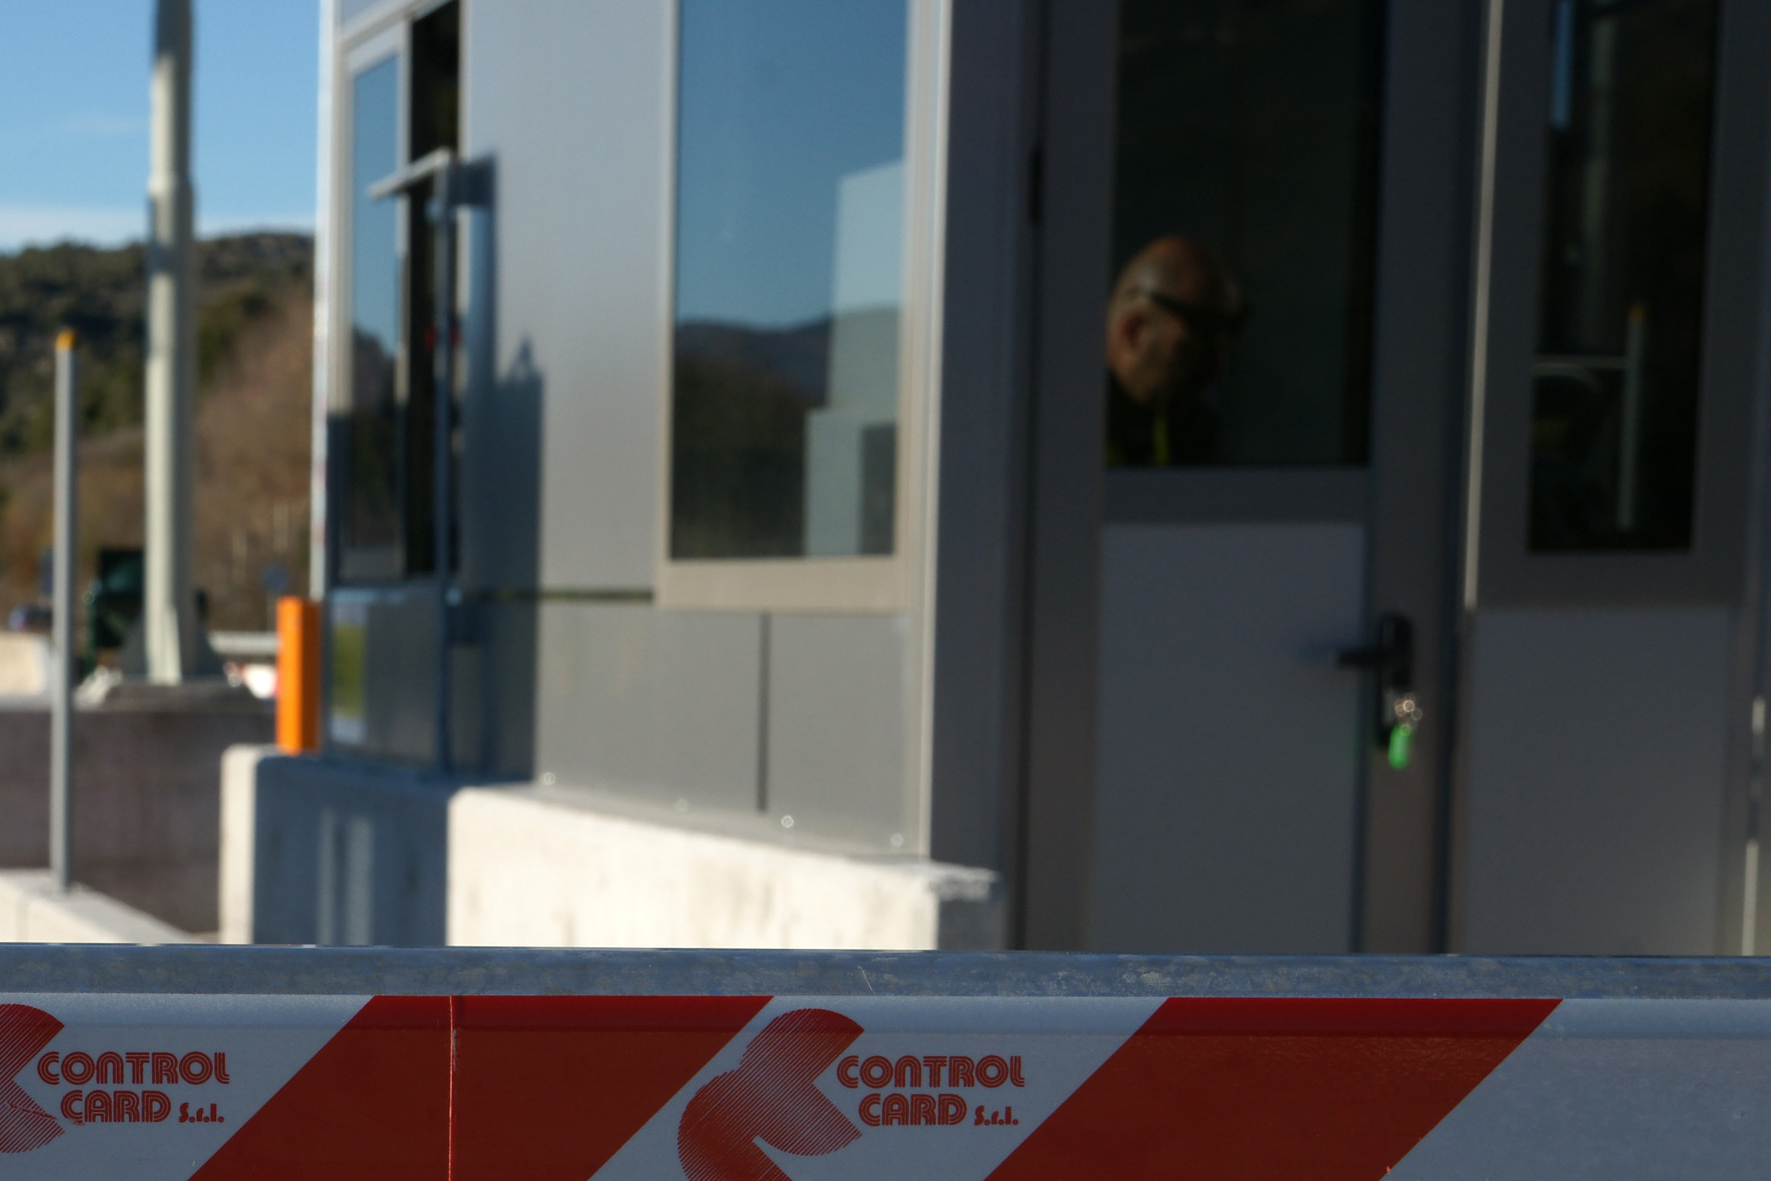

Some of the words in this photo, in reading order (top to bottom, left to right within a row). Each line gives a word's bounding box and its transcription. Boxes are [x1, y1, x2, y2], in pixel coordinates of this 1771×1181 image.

[37, 1051, 230, 1085] CONTROL
[836, 1055, 1025, 1089] CONTROL
[60, 1090, 171, 1123] CARD
[178, 1102, 225, 1123] S.r.l.
[858, 1093, 968, 1127] CARD
[973, 1105, 1019, 1126] S.r.l.
